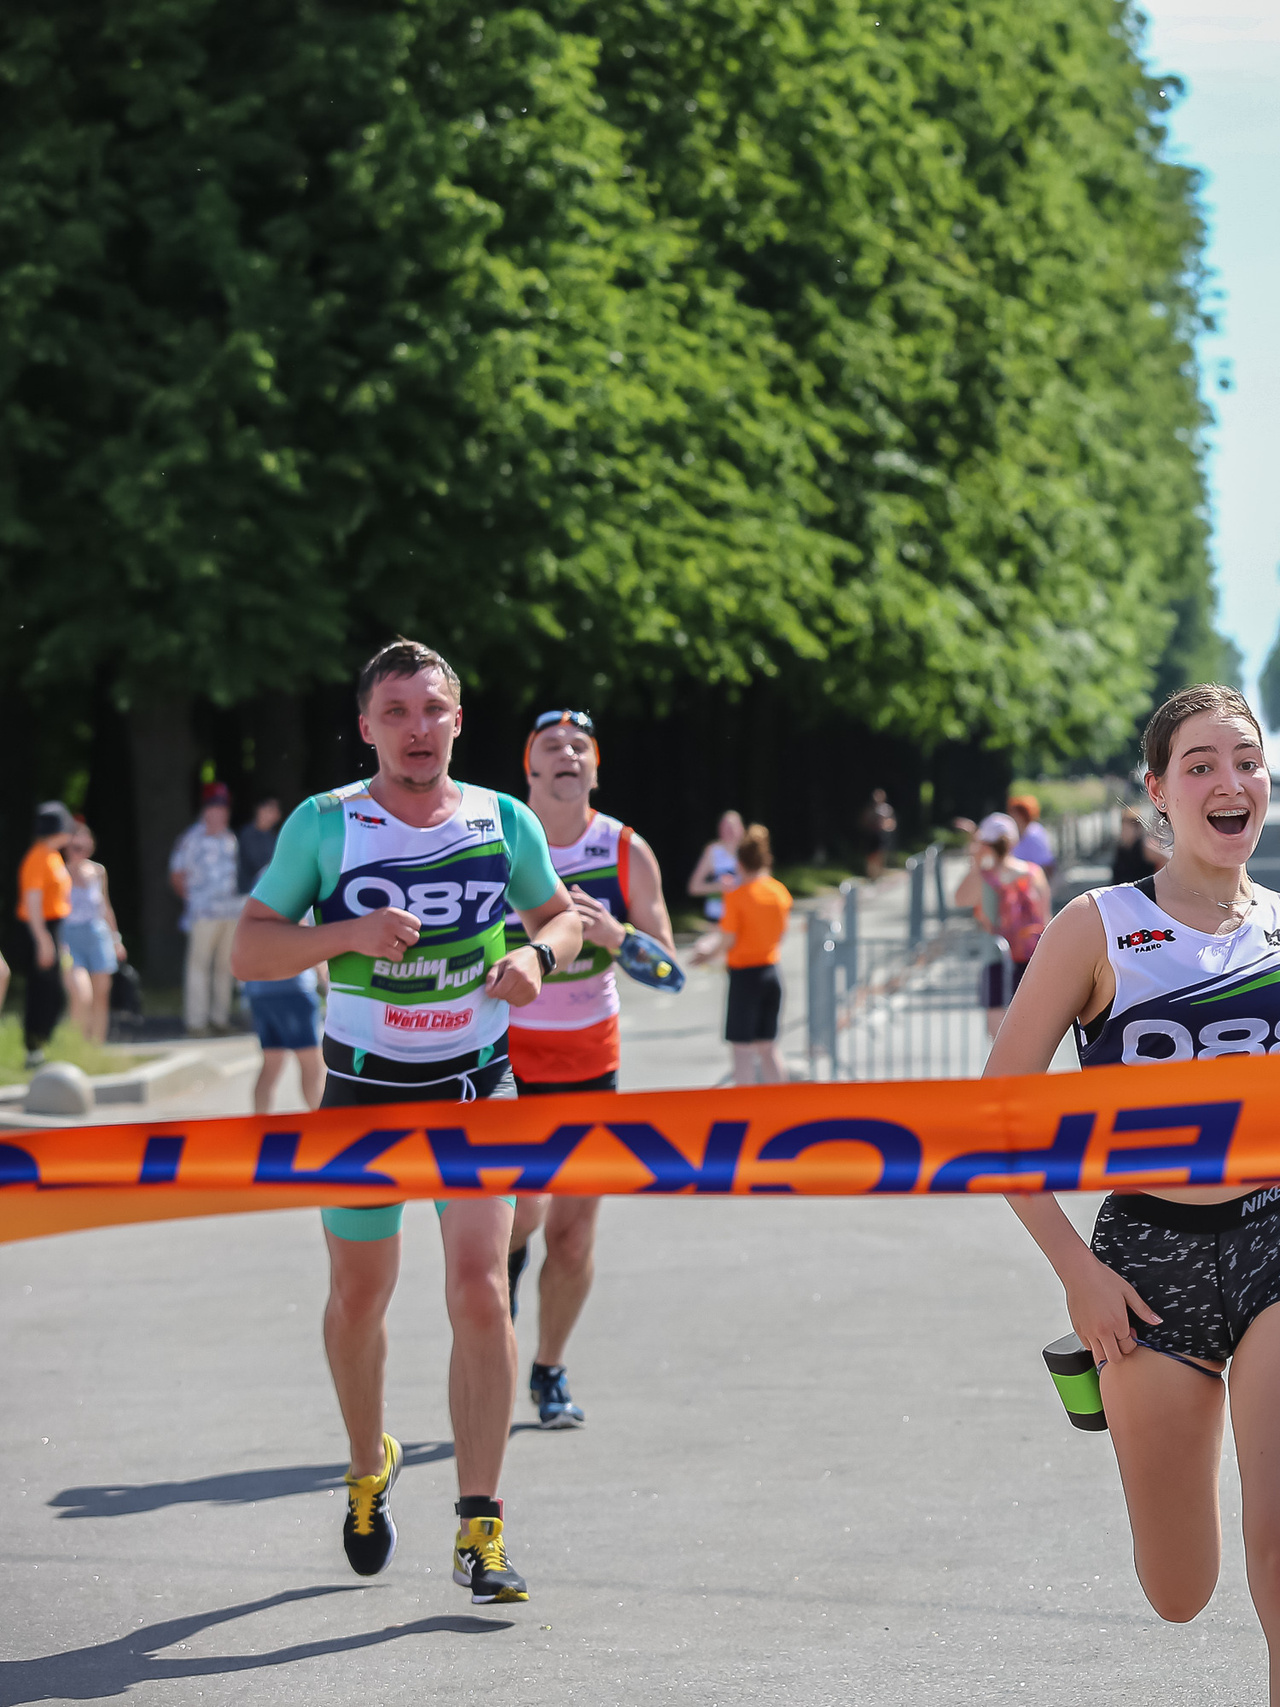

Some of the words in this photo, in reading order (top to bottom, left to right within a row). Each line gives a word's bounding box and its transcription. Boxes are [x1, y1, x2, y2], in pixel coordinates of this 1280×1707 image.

[343, 876, 506, 926] 087
[387, 1007, 431, 1028] World
[432, 1010, 471, 1028] Class
